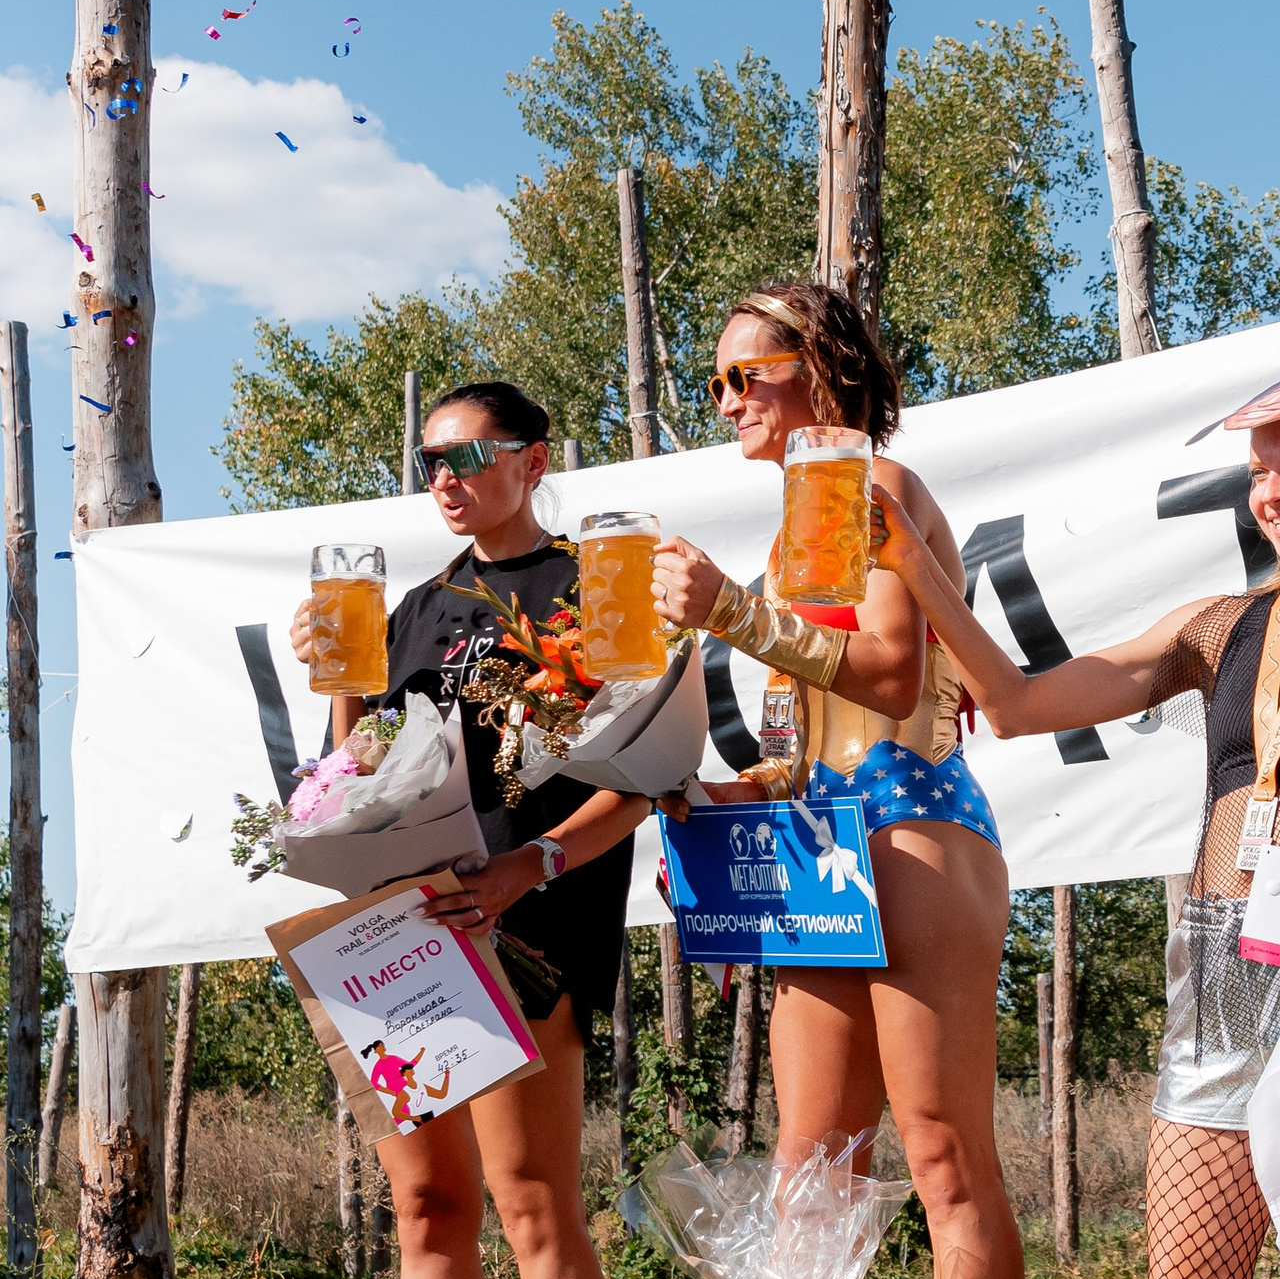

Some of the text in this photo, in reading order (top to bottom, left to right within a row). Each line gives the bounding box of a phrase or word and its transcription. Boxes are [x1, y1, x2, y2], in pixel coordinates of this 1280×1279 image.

[1260, 741, 1280, 785] VOLGA
[729, 863, 791, 892] МЕГАОПТИКА
[335, 937, 366, 957] TRAIL
[372, 911, 410, 937] DRINK
[348, 913, 386, 937] VOLGA
[685, 911, 863, 936] ПОДАРОЧНЫЙ СЕРТИФИКАТ
[342, 939, 443, 1003] II МЕСТО
[386, 980, 443, 1018] ДИПЛОМ ВЫДАН
[434, 1044, 459, 1062] ВРЕМЯ
